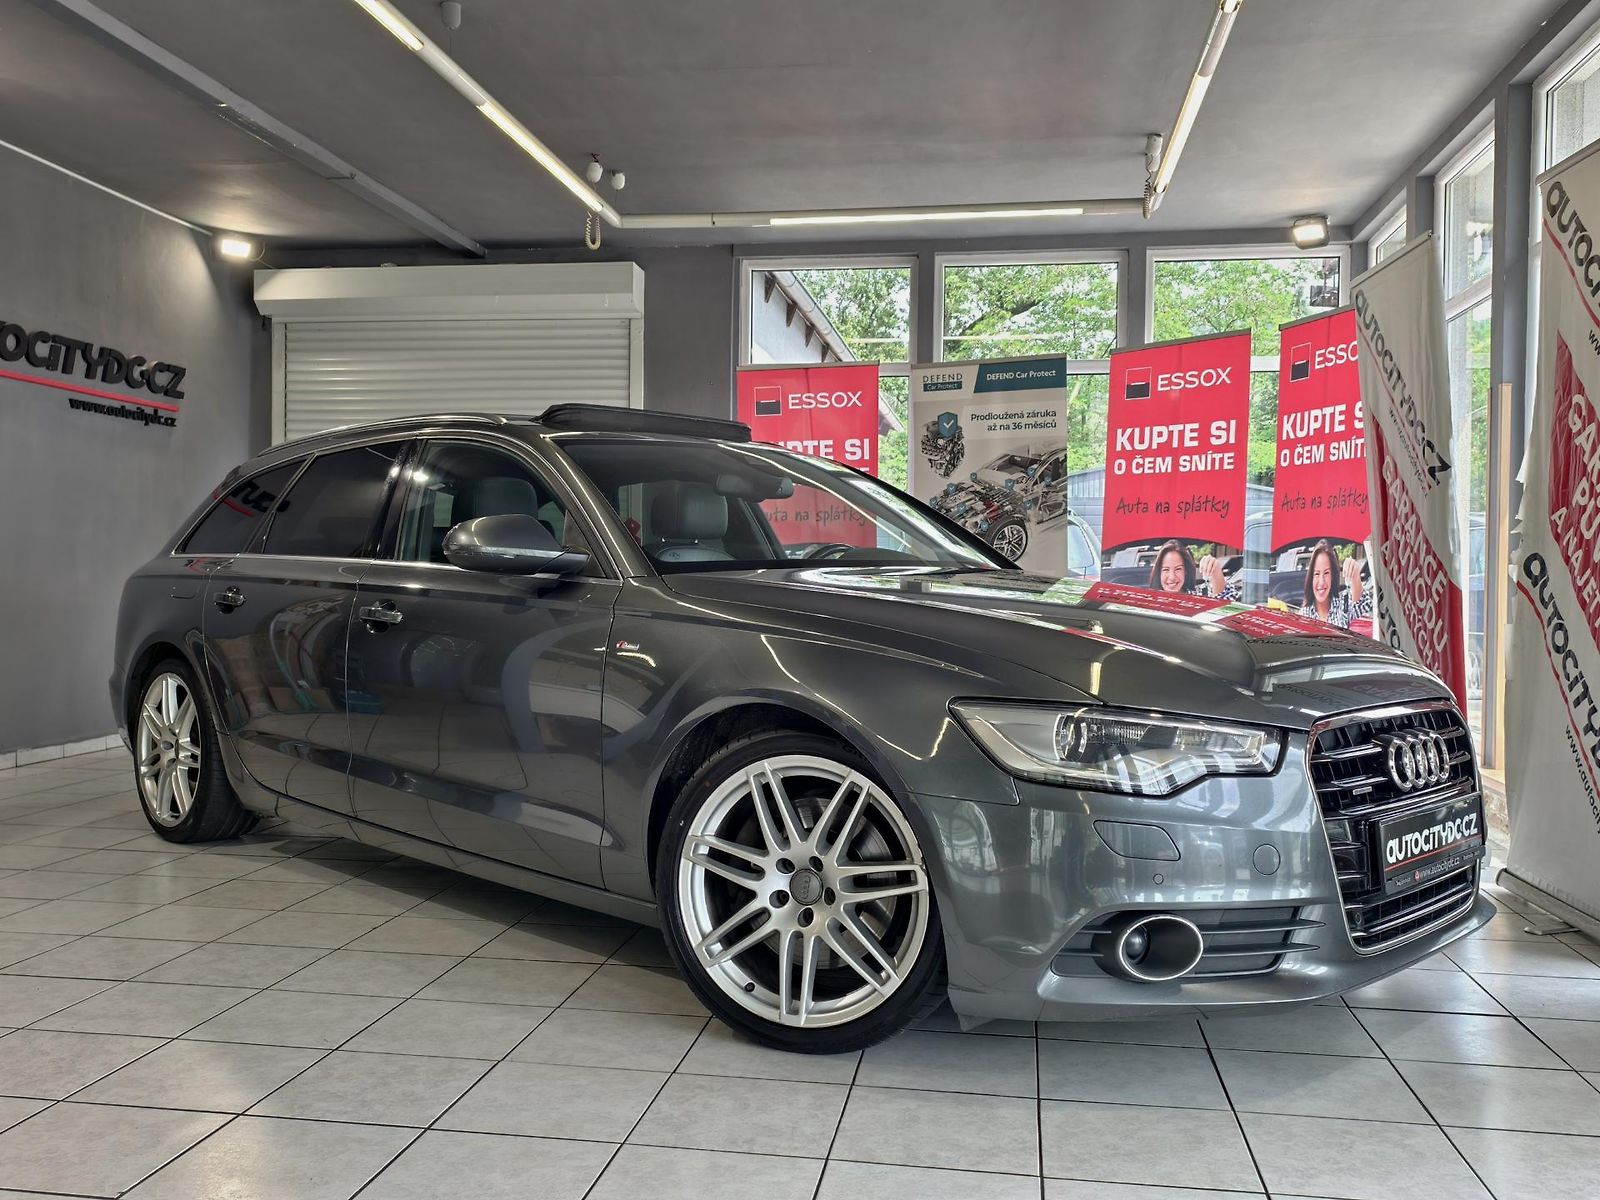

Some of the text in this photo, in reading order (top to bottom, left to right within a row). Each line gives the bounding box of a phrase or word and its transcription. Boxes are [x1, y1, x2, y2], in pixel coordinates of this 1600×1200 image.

[1314, 341, 1358, 369] ESSO
[922, 373, 963, 382] DEFEND
[986, 369, 1056, 381] DEFEND Car Protect
[1157, 367, 1232, 391] ESSOX
[788, 391, 862, 409] ESSOX
[971, 409, 1057, 422] Prodloužená záruka
[987, 423, 999, 432] až
[1012, 422, 1023, 430] 36
[1025, 419, 1057, 430] měsíců
[1282, 401, 1364, 440] KUPTE S
[1116, 420, 1237, 451] KUPTE SI
[779, 438, 870, 460] PTE SI
[1280, 435, 1367, 467] O ČEM SNÍT
[1114, 450, 1235, 475] O ČEM SNÍTE
[1116, 494, 1229, 518] Auta na splátky
[1281, 486, 1369, 514] Auta na splátky
[767, 507, 788, 522] uta
[795, 510, 810, 521] na
[1382, 455, 1448, 603] GARANCE
